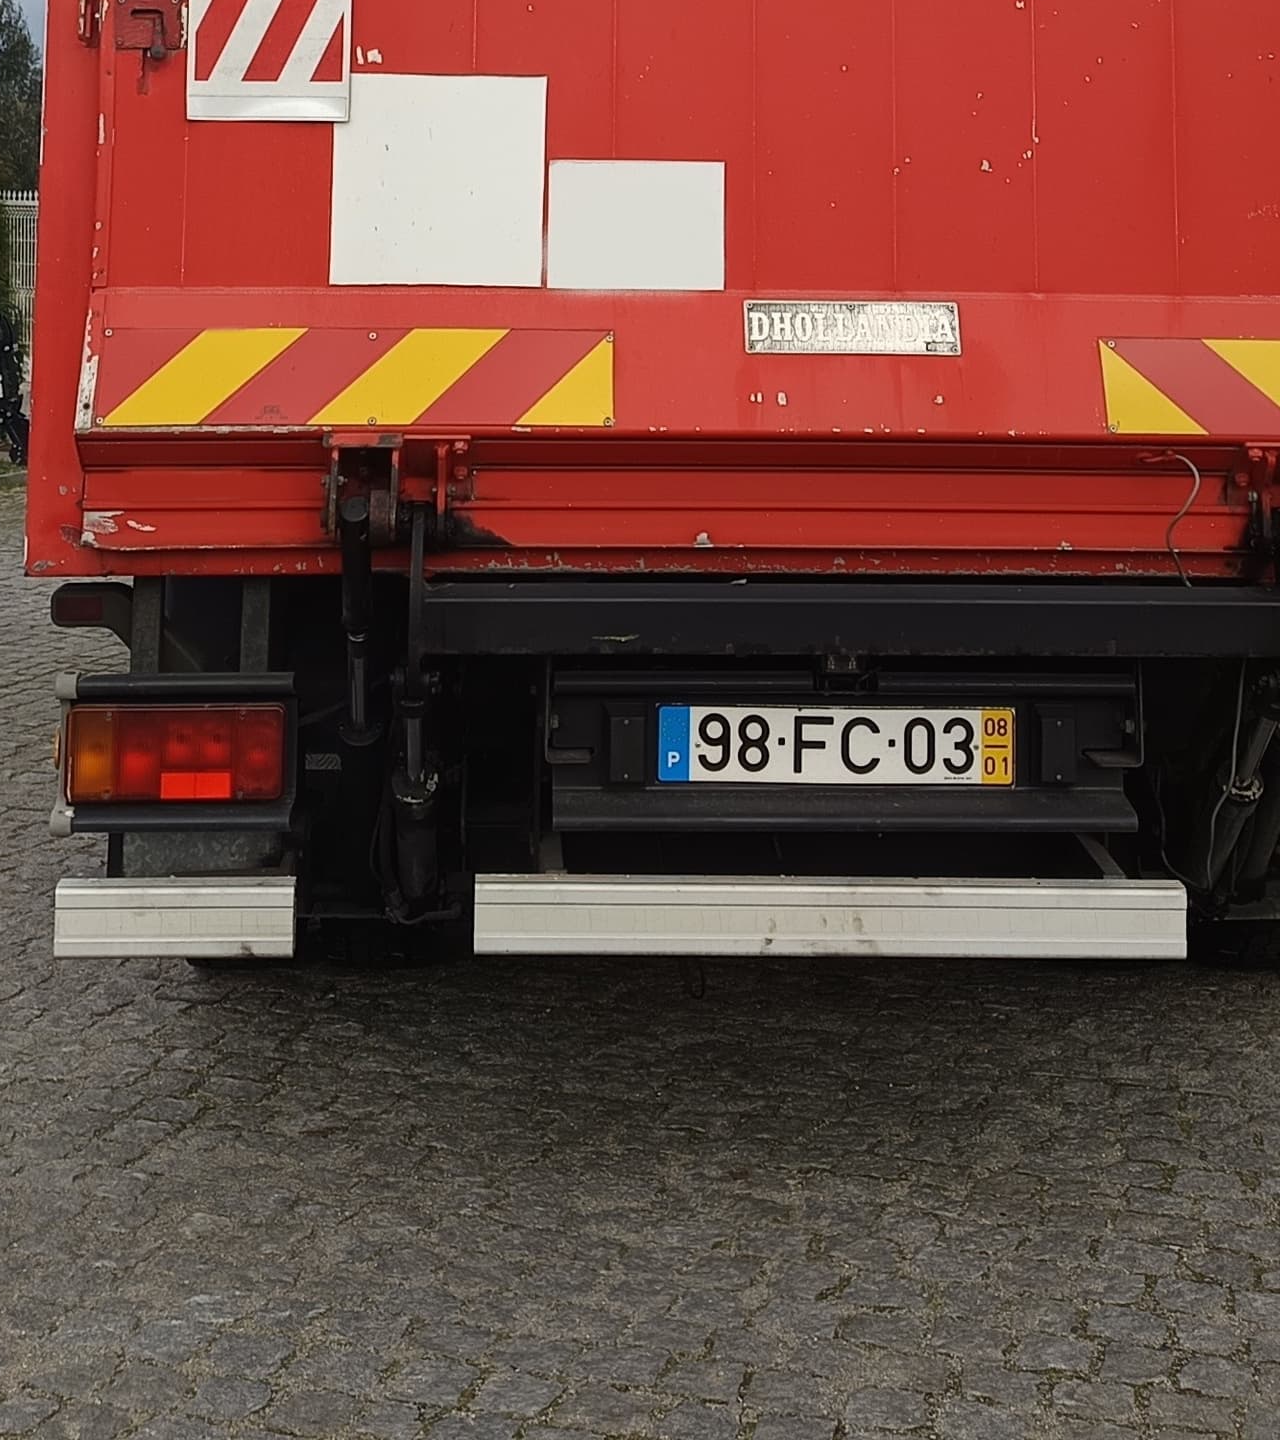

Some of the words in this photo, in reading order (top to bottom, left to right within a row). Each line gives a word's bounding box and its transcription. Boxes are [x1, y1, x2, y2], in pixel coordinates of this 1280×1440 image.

[749, 311, 955, 344] DHOLLANDIA
[984, 717, 1008, 737] 08
[667, 751, 680, 769] P
[984, 756, 1009, 777] 01
